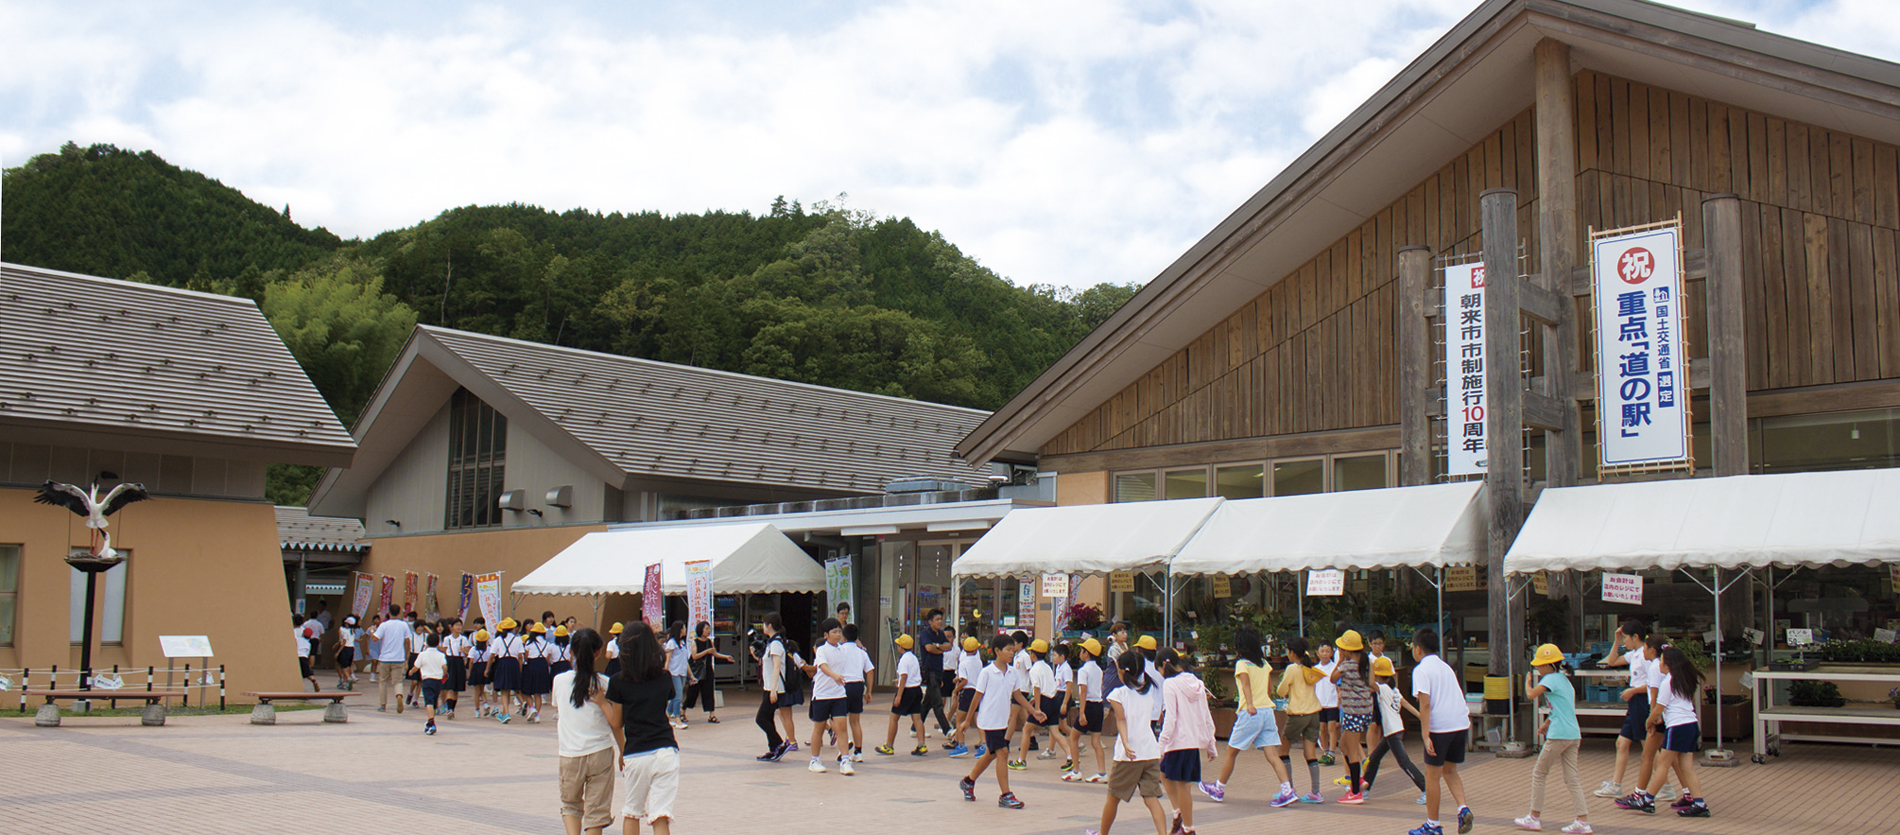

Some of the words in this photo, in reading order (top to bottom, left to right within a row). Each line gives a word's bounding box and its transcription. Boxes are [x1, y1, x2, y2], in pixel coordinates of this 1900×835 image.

[1622, 251, 1651, 282] 祝
[1616, 290, 1652, 438] 重点「道の駅」
[1656, 305, 1670, 370] 国土交通省
[1460, 293, 1484, 453] 朝来市市制施行10周年
[1658, 373, 1674, 405] 選定
